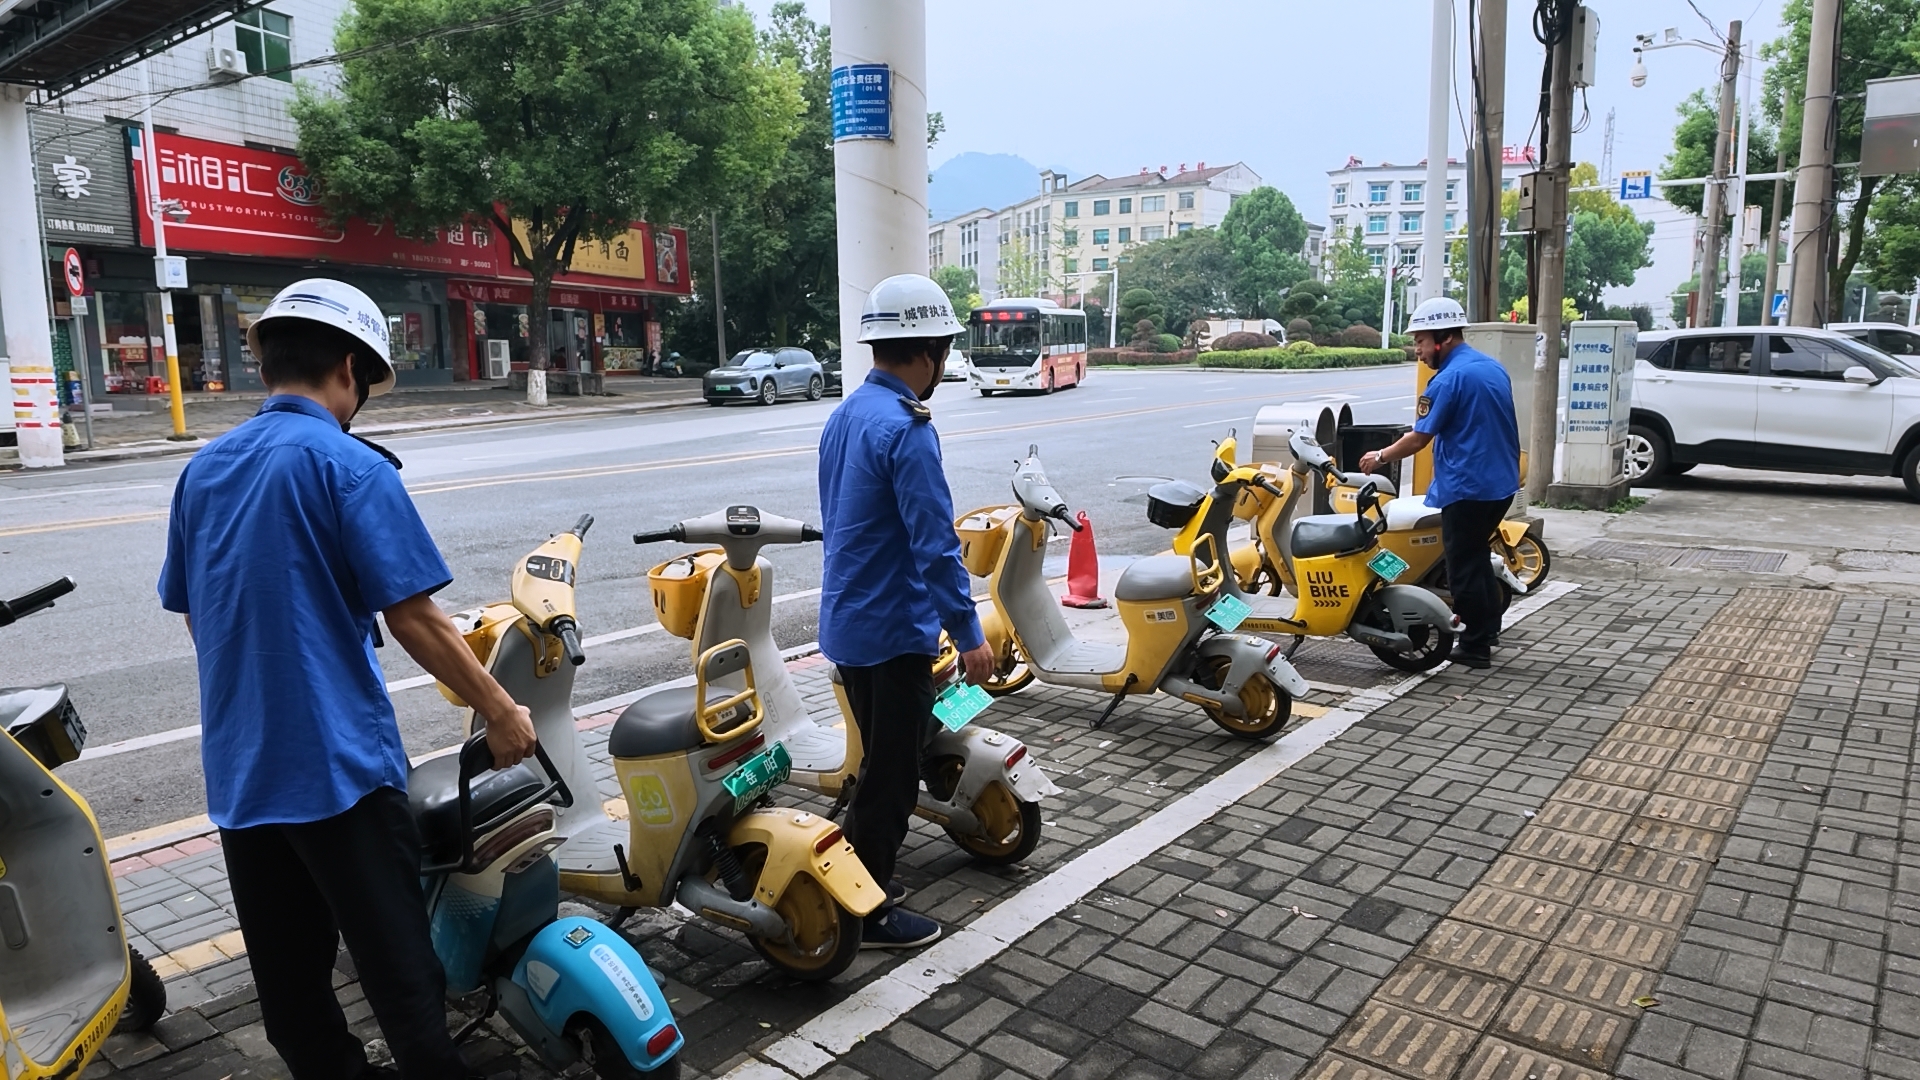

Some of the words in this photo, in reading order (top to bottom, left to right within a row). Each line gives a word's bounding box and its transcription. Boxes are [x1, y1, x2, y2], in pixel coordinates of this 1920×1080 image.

[53, 154, 92, 199] 家
[904, 304, 949, 321] 城管执法
[1573, 364, 1611, 374] 上网速度快
[1572, 382, 1609, 392] 服务响应快
[1306, 571, 1334, 585] LIU
[1309, 585, 1350, 598] BIKE
[1156, 610, 1176, 621] 美团
[744, 756, 779, 786] 岳阳
